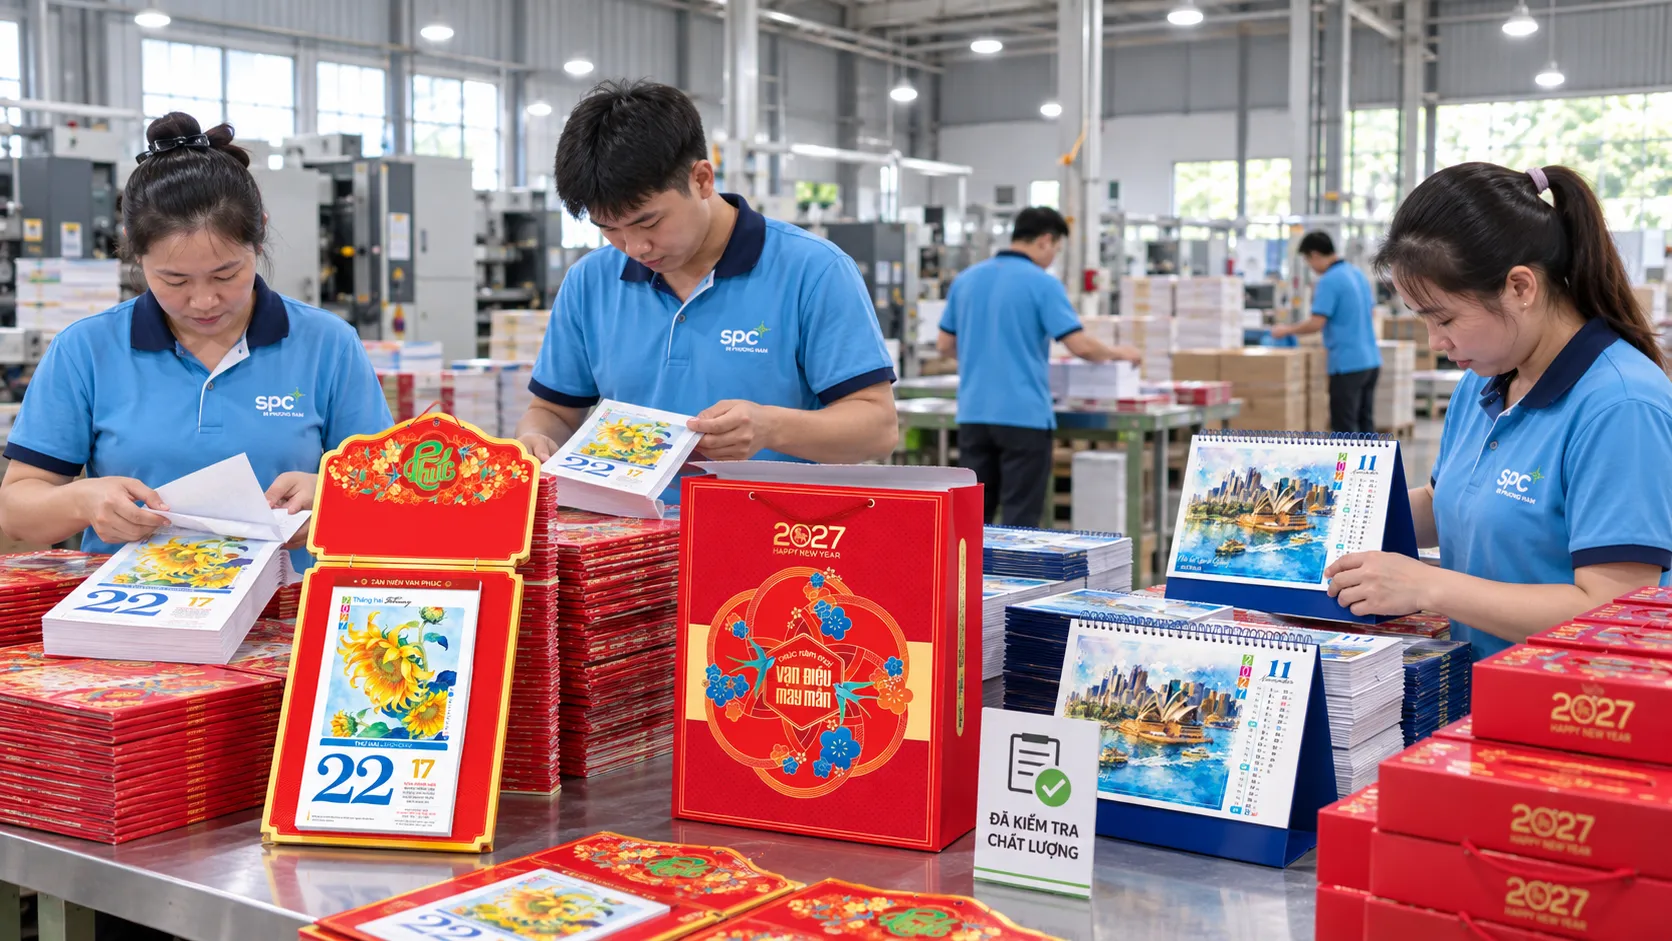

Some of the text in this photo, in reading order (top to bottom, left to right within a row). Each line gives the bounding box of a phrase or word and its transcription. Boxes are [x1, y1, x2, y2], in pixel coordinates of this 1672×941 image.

[558, 456, 643, 478] 22 17
[1358, 454, 1377, 471] 11
[773, 522, 846, 550] 2027
[773, 547, 841, 559] HAPPY NEW YEAR
[73, 589, 168, 617] 22
[188, 596, 215, 607] 17
[1267, 659, 1292, 679] 11
[1551, 692, 1635, 729] 2027
[311, 752, 394, 806] 22
[411, 758, 436, 779] 17
[989, 810, 1010, 828] ĐÃ
[1051, 820, 1079, 838] TRA
[1510, 803, 1596, 843] 2027
[987, 832, 1079, 860] CHẤT LƯỢNG
[1505, 876, 1590, 918] 2027
